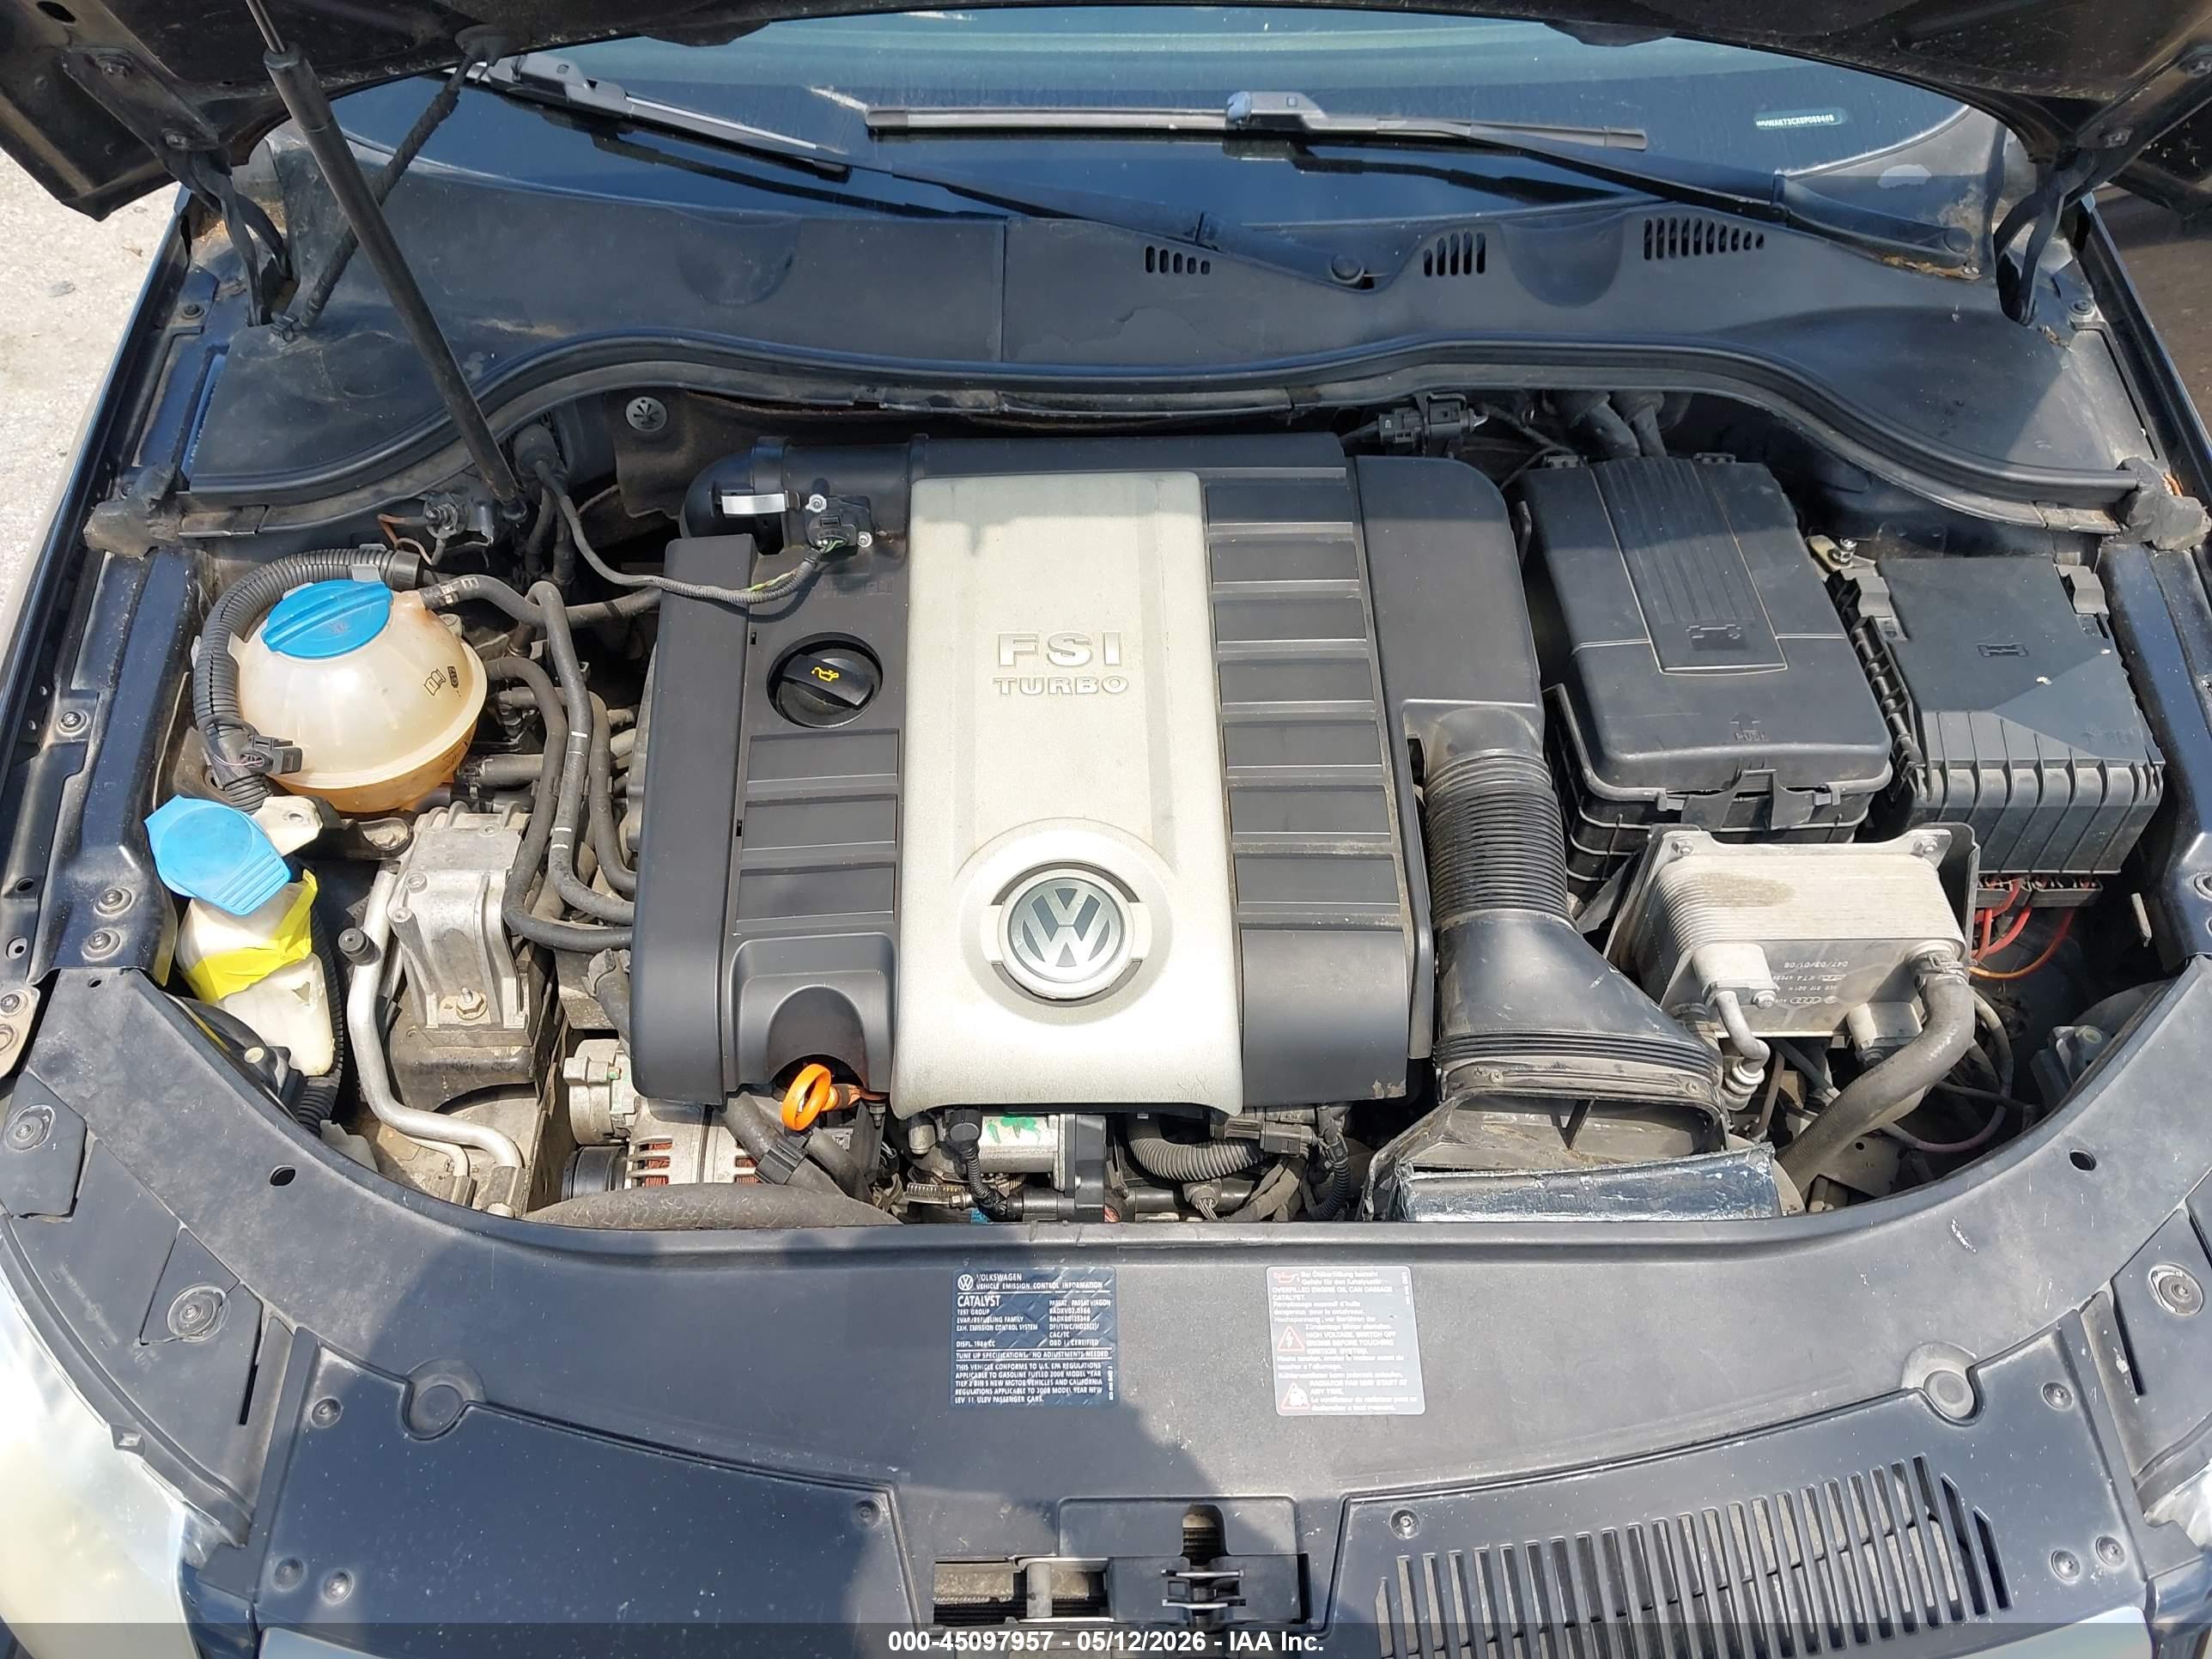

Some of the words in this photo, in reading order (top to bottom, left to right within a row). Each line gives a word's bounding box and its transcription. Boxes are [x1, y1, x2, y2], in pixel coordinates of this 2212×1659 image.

[997, 631, 1121, 667] FSI
[993, 676, 1128, 695] TURBO
[957, 1295, 1000, 1307] CATALYST
